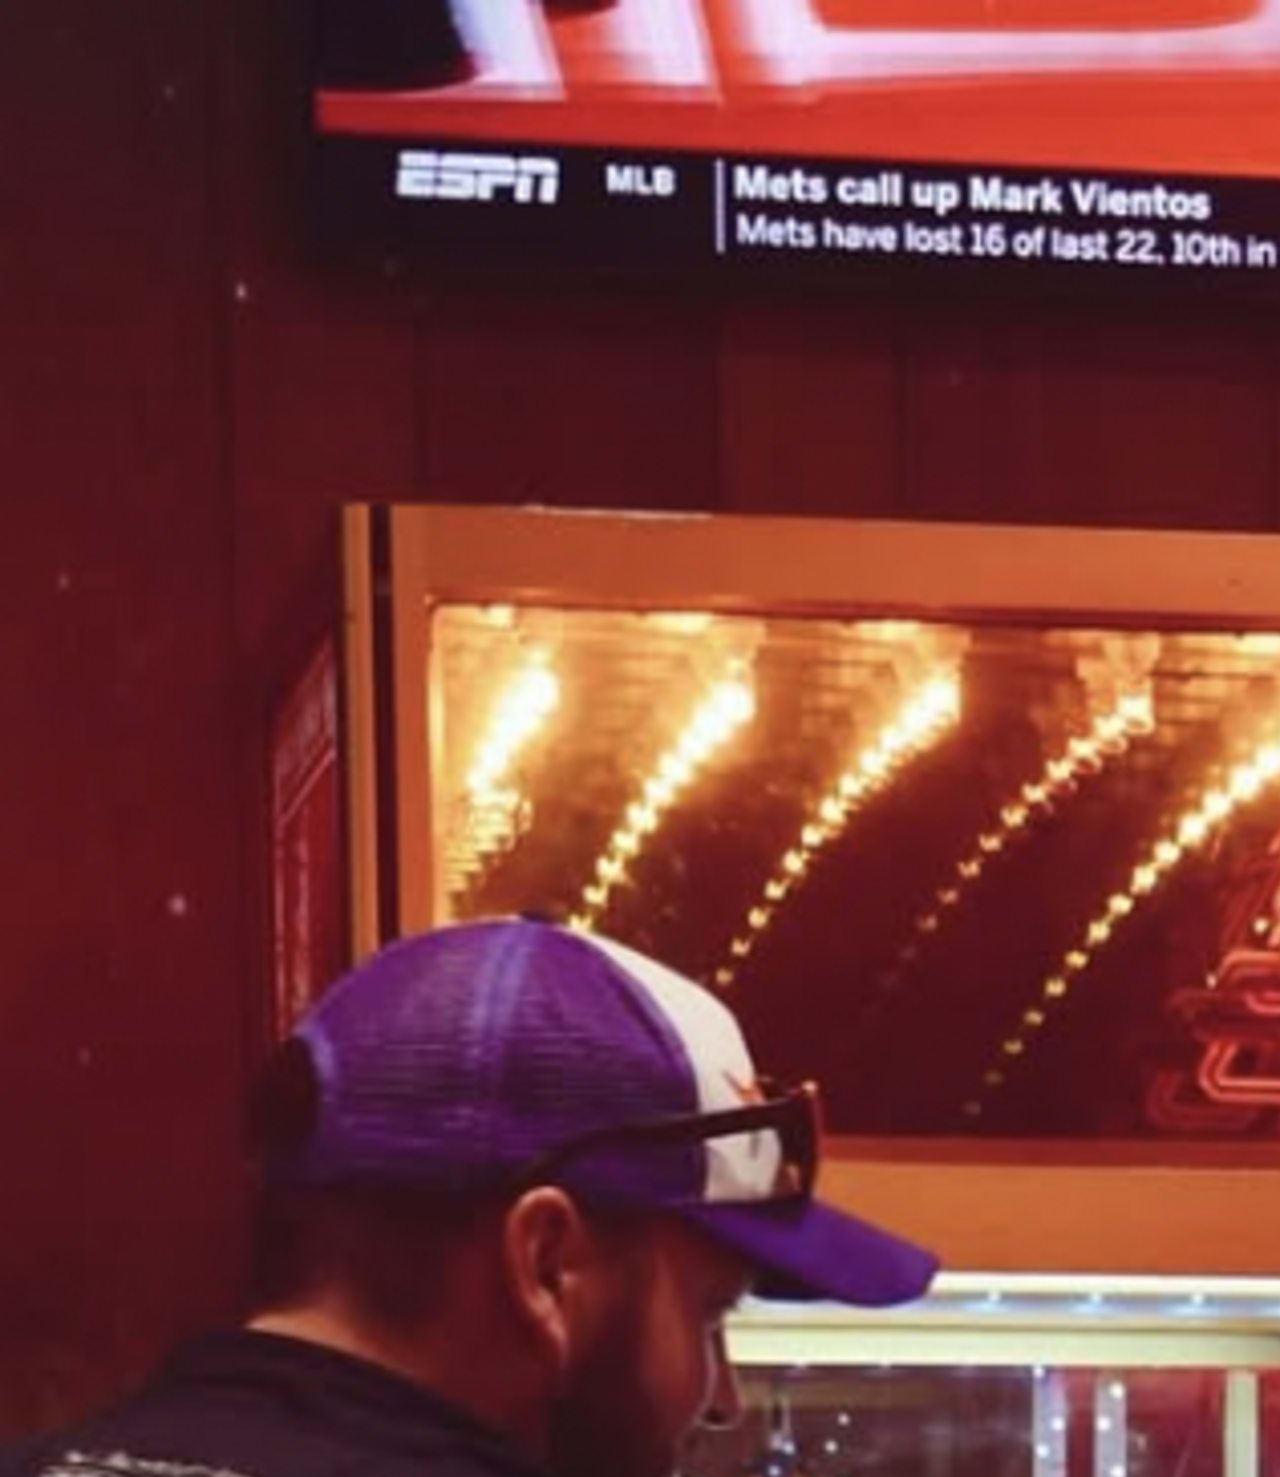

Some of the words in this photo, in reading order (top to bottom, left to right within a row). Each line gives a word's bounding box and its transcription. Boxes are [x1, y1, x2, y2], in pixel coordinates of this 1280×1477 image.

[396, 151, 560, 203] ESPN
[606, 164, 676, 196] MLB
[733, 165, 827, 202] Mets
[837, 173, 901, 207] call
[911, 181, 960, 216] up
[969, 177, 1063, 213] Mark
[1069, 180, 1212, 219] Vientos
[736, 214, 817, 247] Mets
[822, 218, 898, 251] have
[904, 221, 964, 254] lost
[970, 224, 1006, 255] 16
[1013, 226, 1045, 257] of
[1052, 229, 1109, 260] last
[1171, 232, 1241, 266] 10th
[1248, 236, 1276, 267] in
